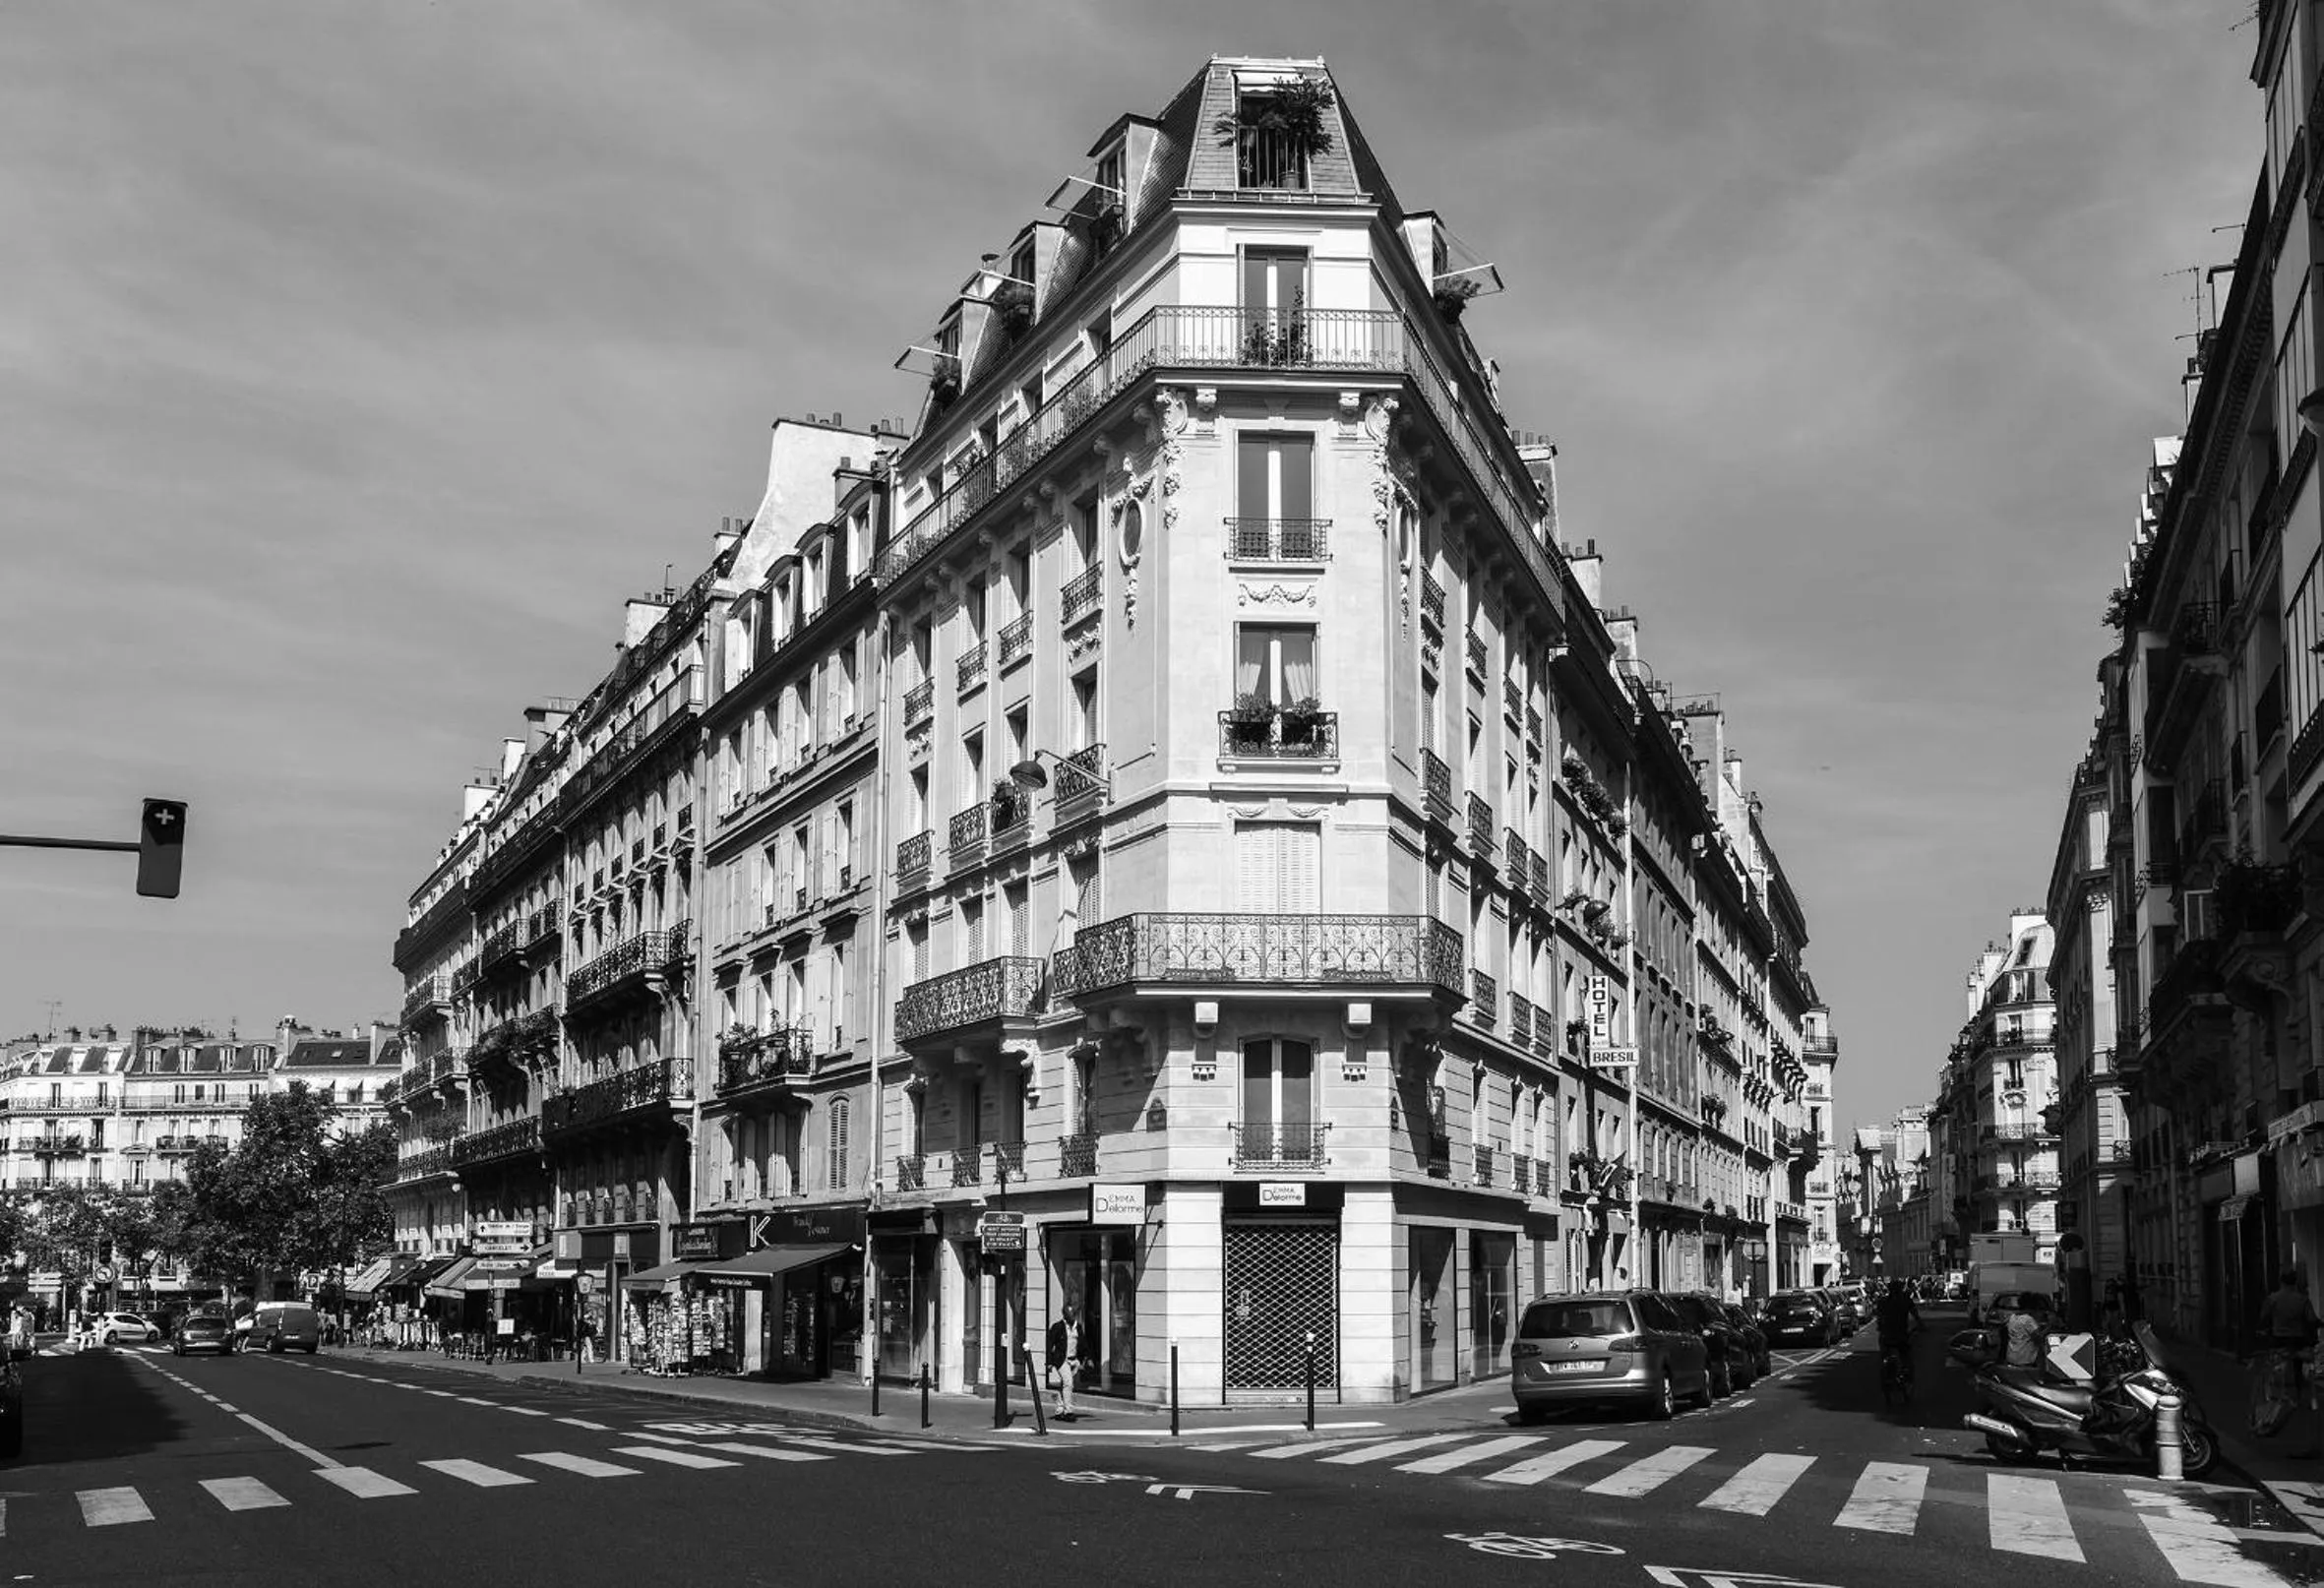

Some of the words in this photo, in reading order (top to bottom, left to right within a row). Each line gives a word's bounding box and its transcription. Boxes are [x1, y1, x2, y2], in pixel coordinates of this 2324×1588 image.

[1592, 977, 1606, 1036] HOTEL
[1593, 1051, 1637, 1063] BRESIL
[749, 1215, 772, 1249] K
